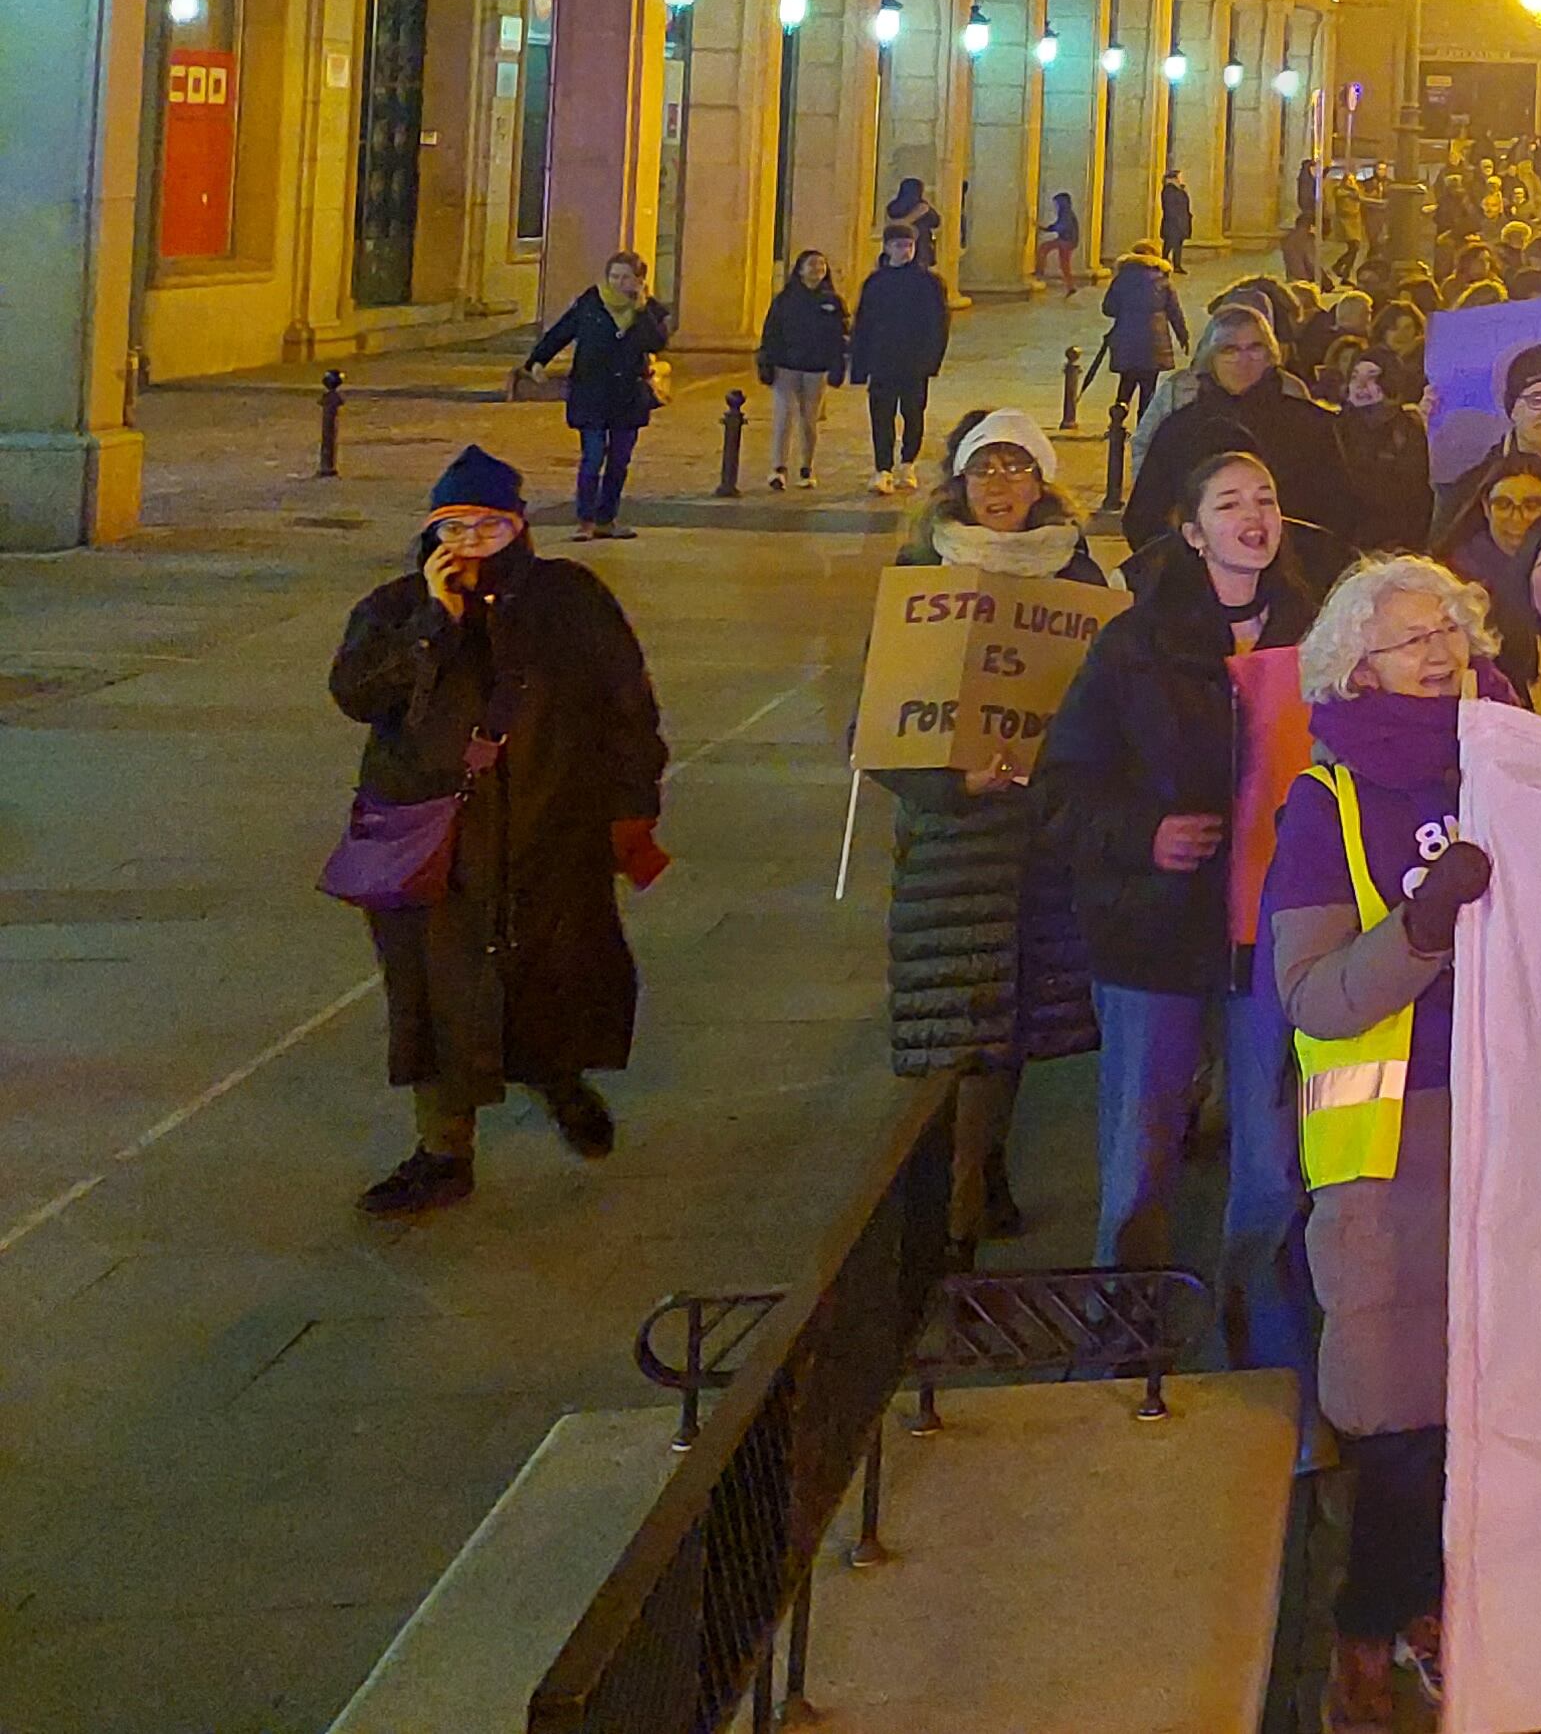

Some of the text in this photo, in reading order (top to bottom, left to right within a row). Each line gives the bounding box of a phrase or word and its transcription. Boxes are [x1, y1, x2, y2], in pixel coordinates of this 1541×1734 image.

[905, 592, 1098, 640] ESTA LUCHA
[982, 644, 1026, 677] ES
[897, 700, 959, 737] POR
